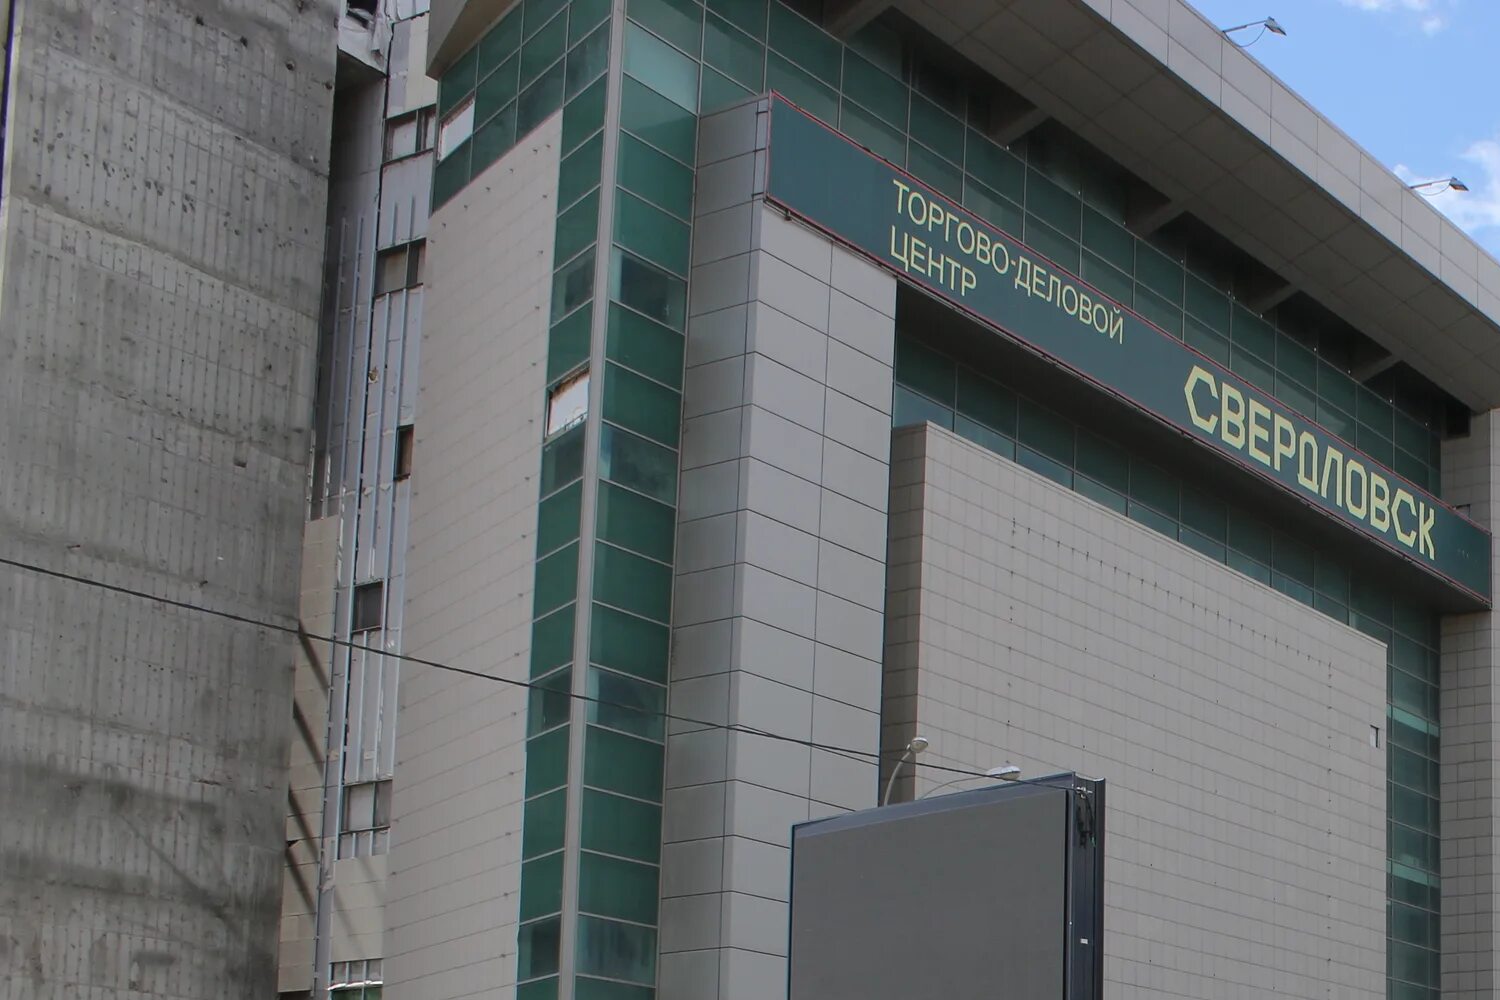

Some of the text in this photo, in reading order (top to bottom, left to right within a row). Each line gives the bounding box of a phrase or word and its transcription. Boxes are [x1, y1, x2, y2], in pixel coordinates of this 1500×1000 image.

[890, 225, 977, 296] ЦЕНТР
[893, 179, 1124, 344] ТОРГОВО-ДЕЛОВОЙ
[1184, 365, 1435, 560] СВЕРДЛОВСК
